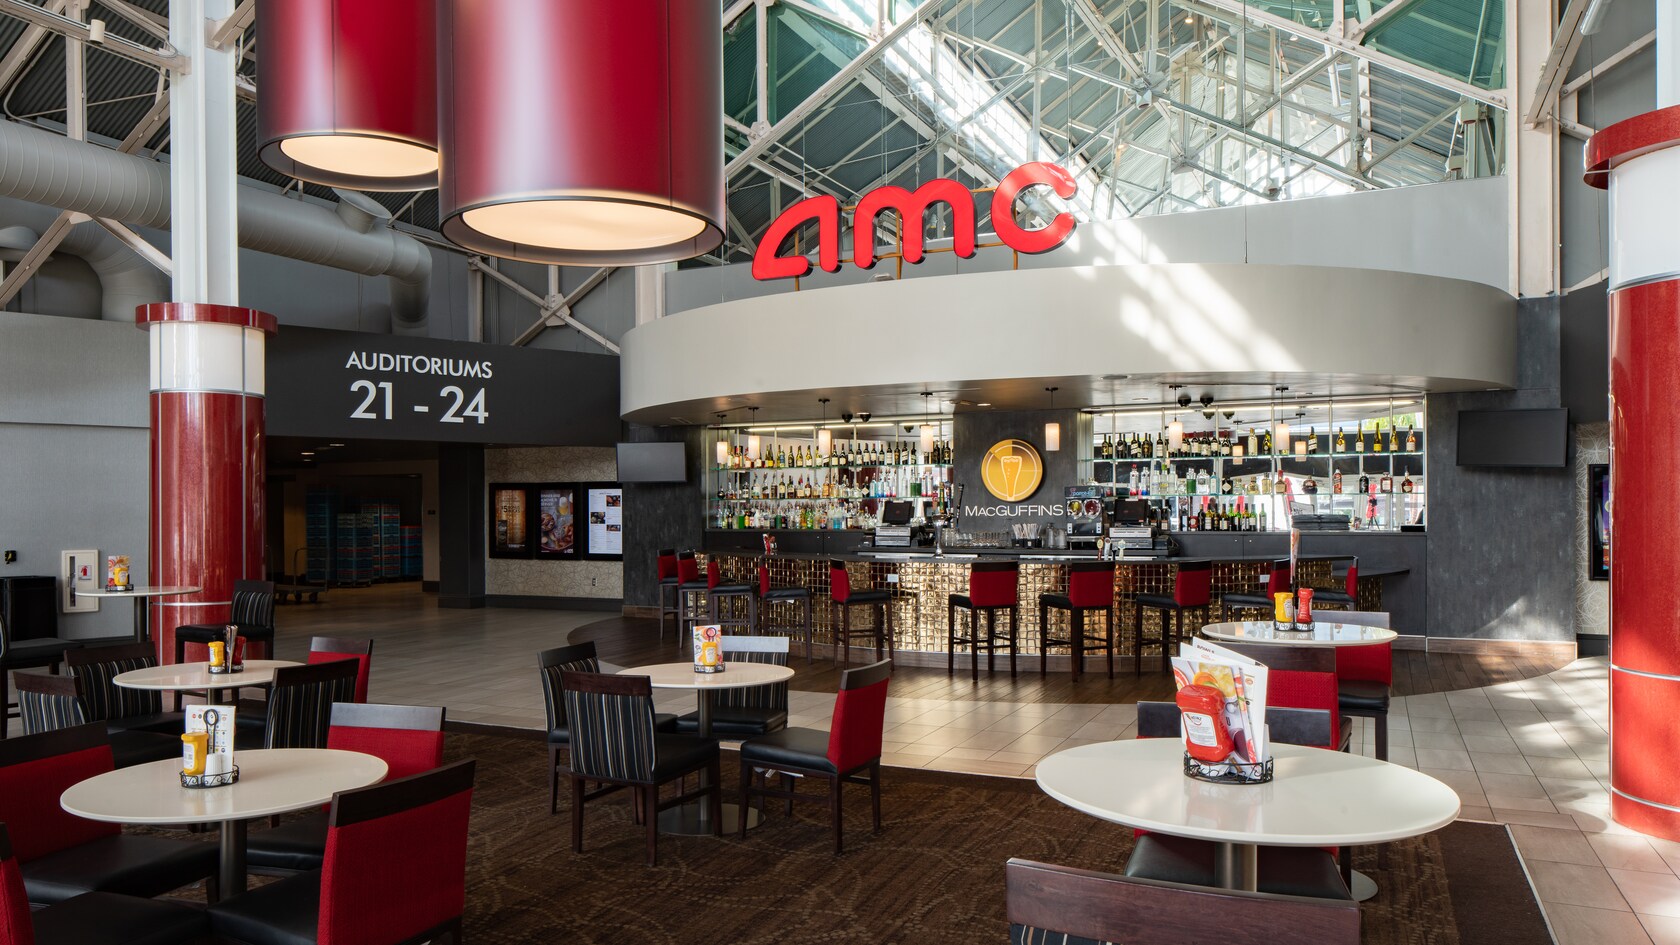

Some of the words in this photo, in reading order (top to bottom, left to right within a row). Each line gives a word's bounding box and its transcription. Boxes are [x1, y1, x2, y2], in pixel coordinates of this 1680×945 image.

[751, 161, 1078, 281] amc
[345, 351, 493, 379] AUDITORIUMS
[350, 379, 393, 420] 21
[439, 385, 489, 424] 24
